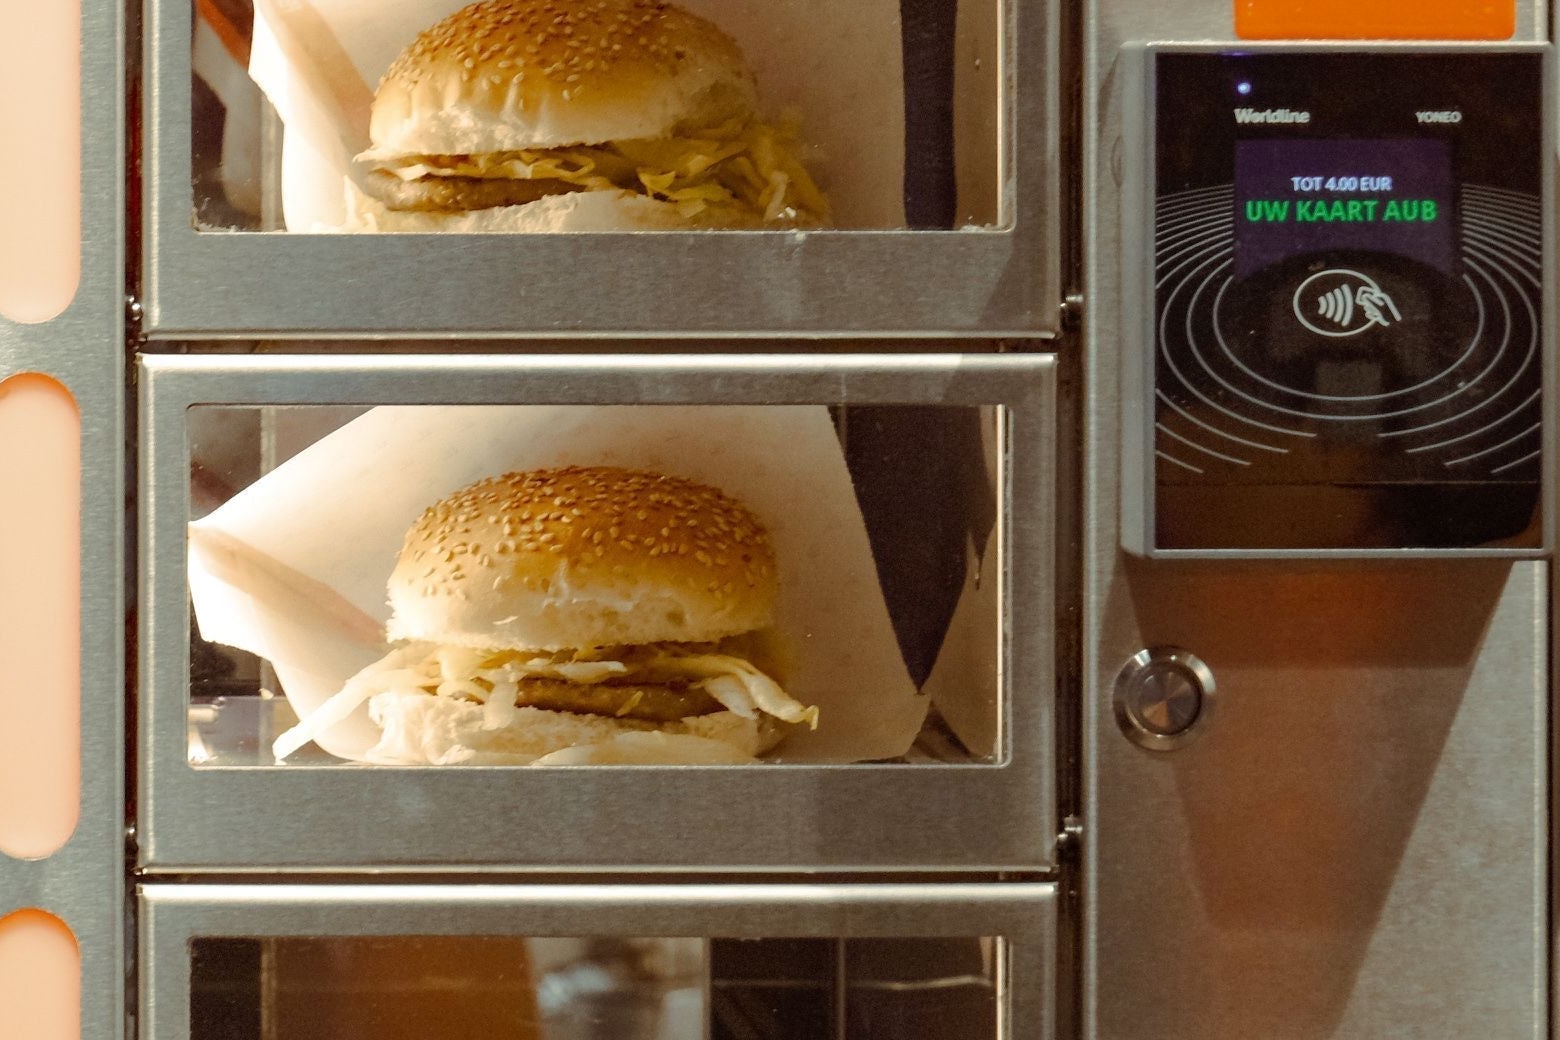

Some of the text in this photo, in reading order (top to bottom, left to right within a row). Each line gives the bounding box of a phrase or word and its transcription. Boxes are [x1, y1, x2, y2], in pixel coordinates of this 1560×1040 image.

[1290, 176, 1323, 192] TOT
[1360, 176, 1393, 192] EUR
[1246, 199, 1437, 222] UW KAART AUB
